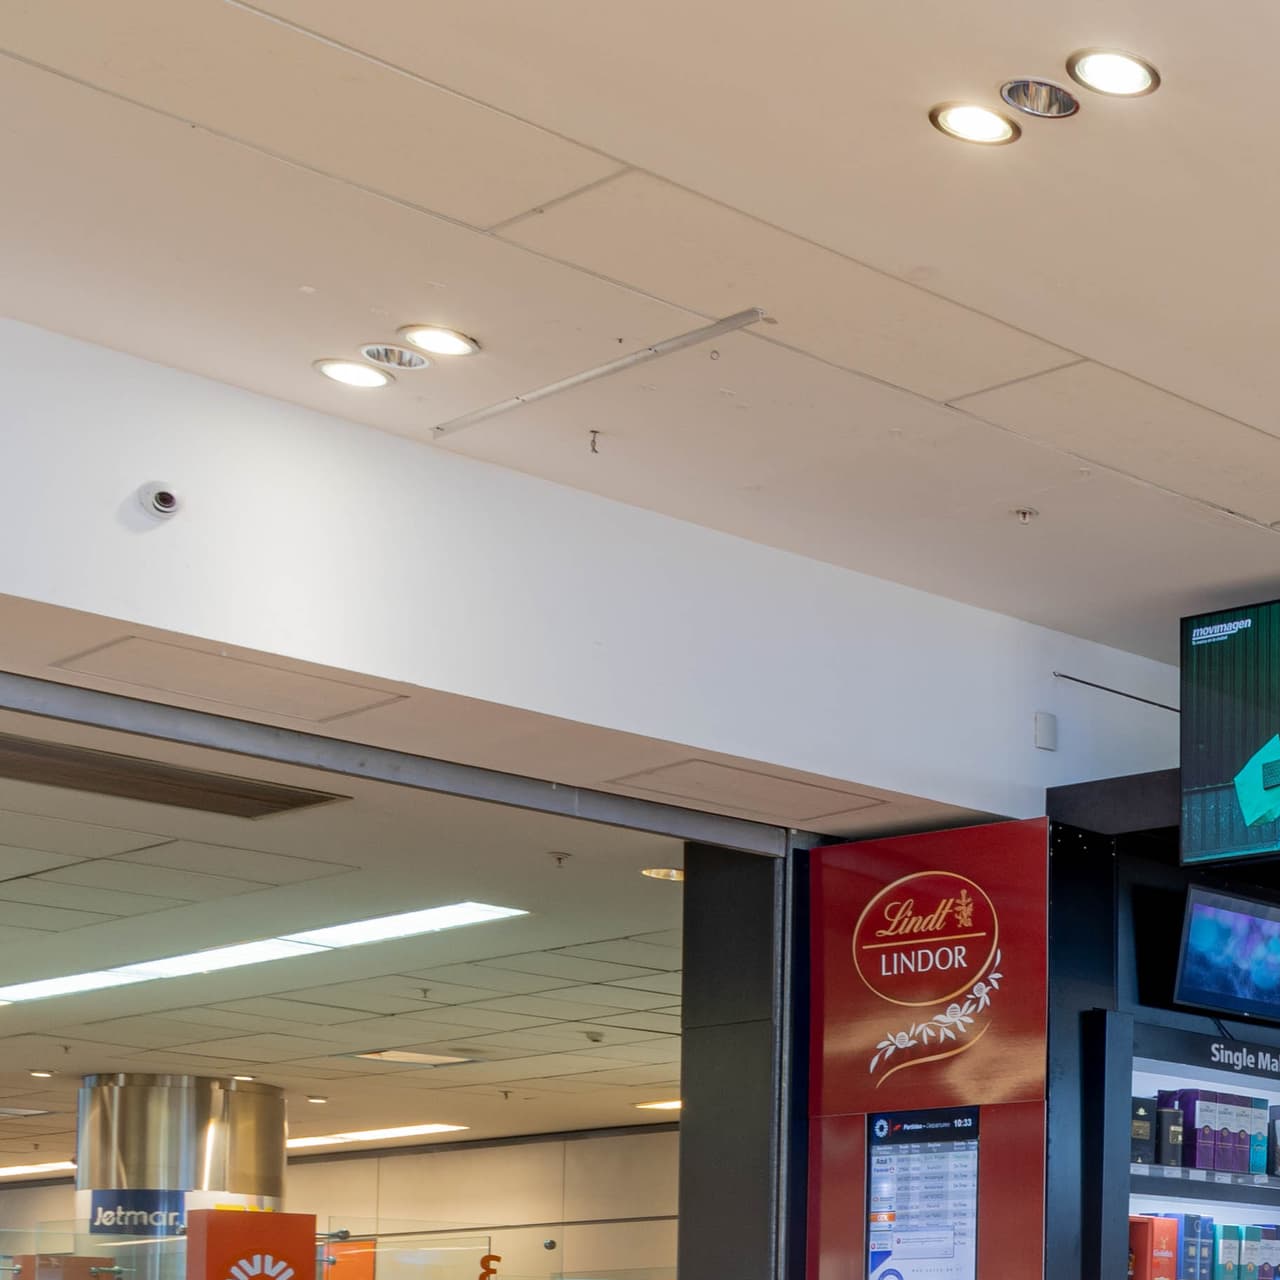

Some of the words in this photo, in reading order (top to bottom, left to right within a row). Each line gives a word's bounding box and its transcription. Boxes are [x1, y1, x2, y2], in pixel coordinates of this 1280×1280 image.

[876, 898, 955, 937] Lindt
[881, 946, 968, 976] LINDOR
[1211, 1043, 1254, 1070] Single
